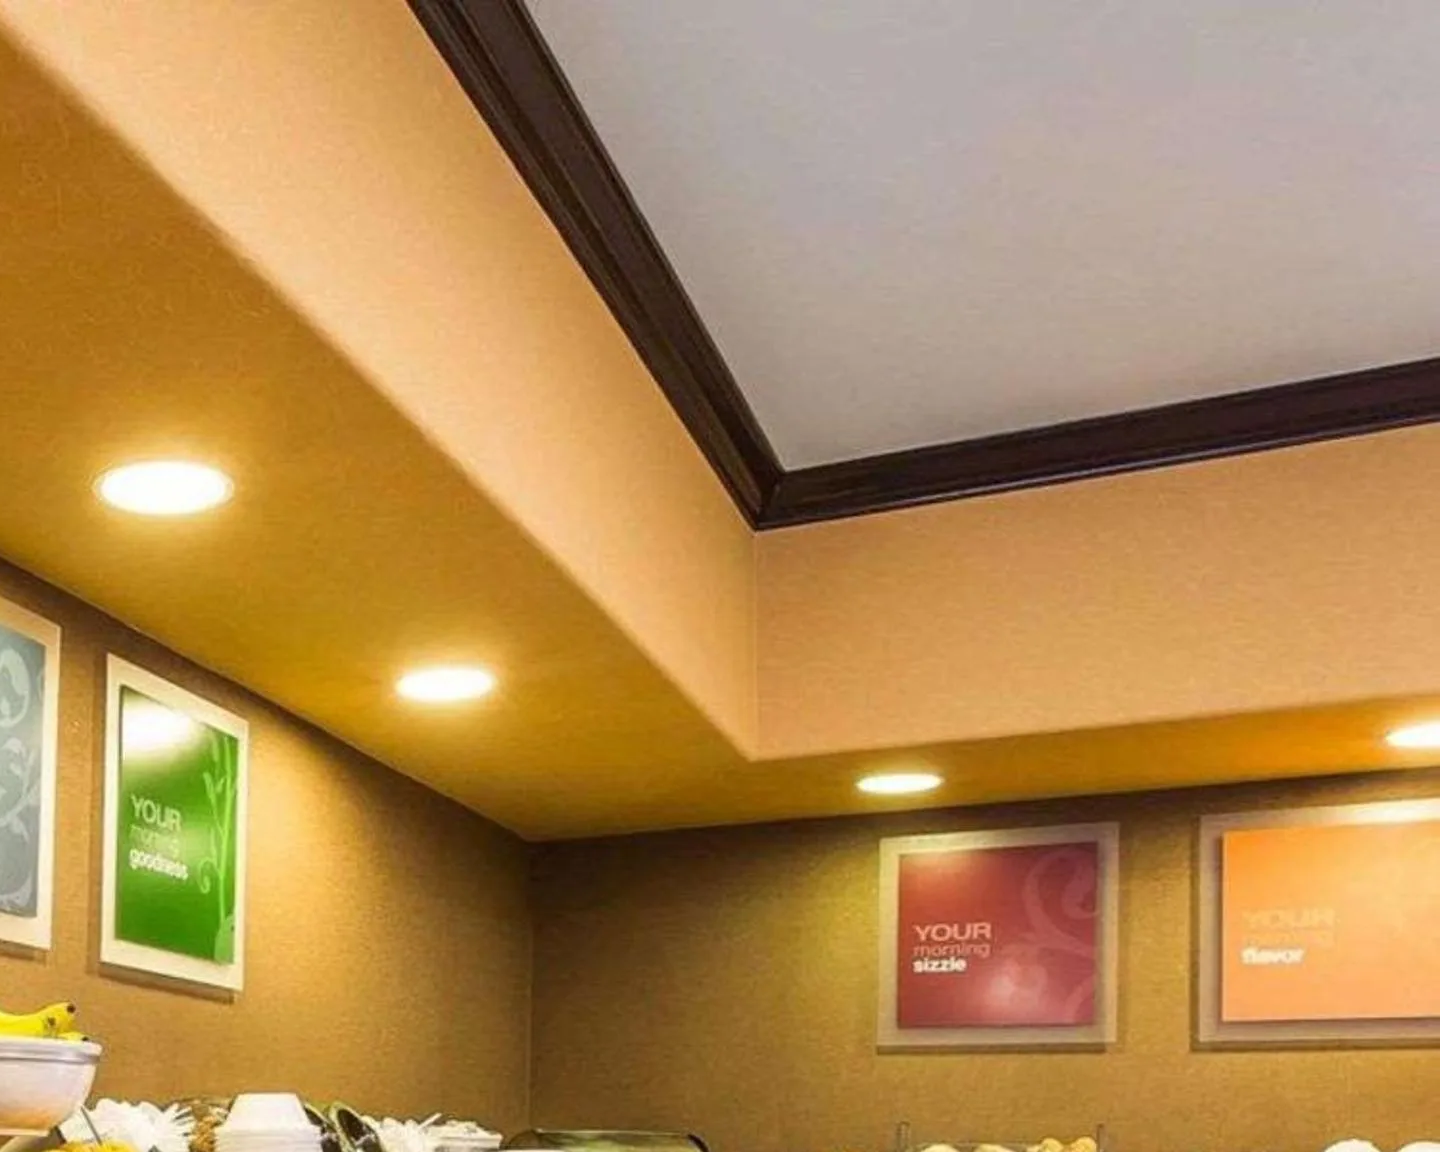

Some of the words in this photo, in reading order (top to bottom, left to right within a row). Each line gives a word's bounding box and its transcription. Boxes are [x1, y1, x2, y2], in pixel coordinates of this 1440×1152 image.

[131, 793, 182, 831] YOUR
[128, 848, 189, 880] goodness
[912, 921, 992, 942] YOUR
[913, 942, 991, 959] morning
[912, 956, 967, 974] sizzle
